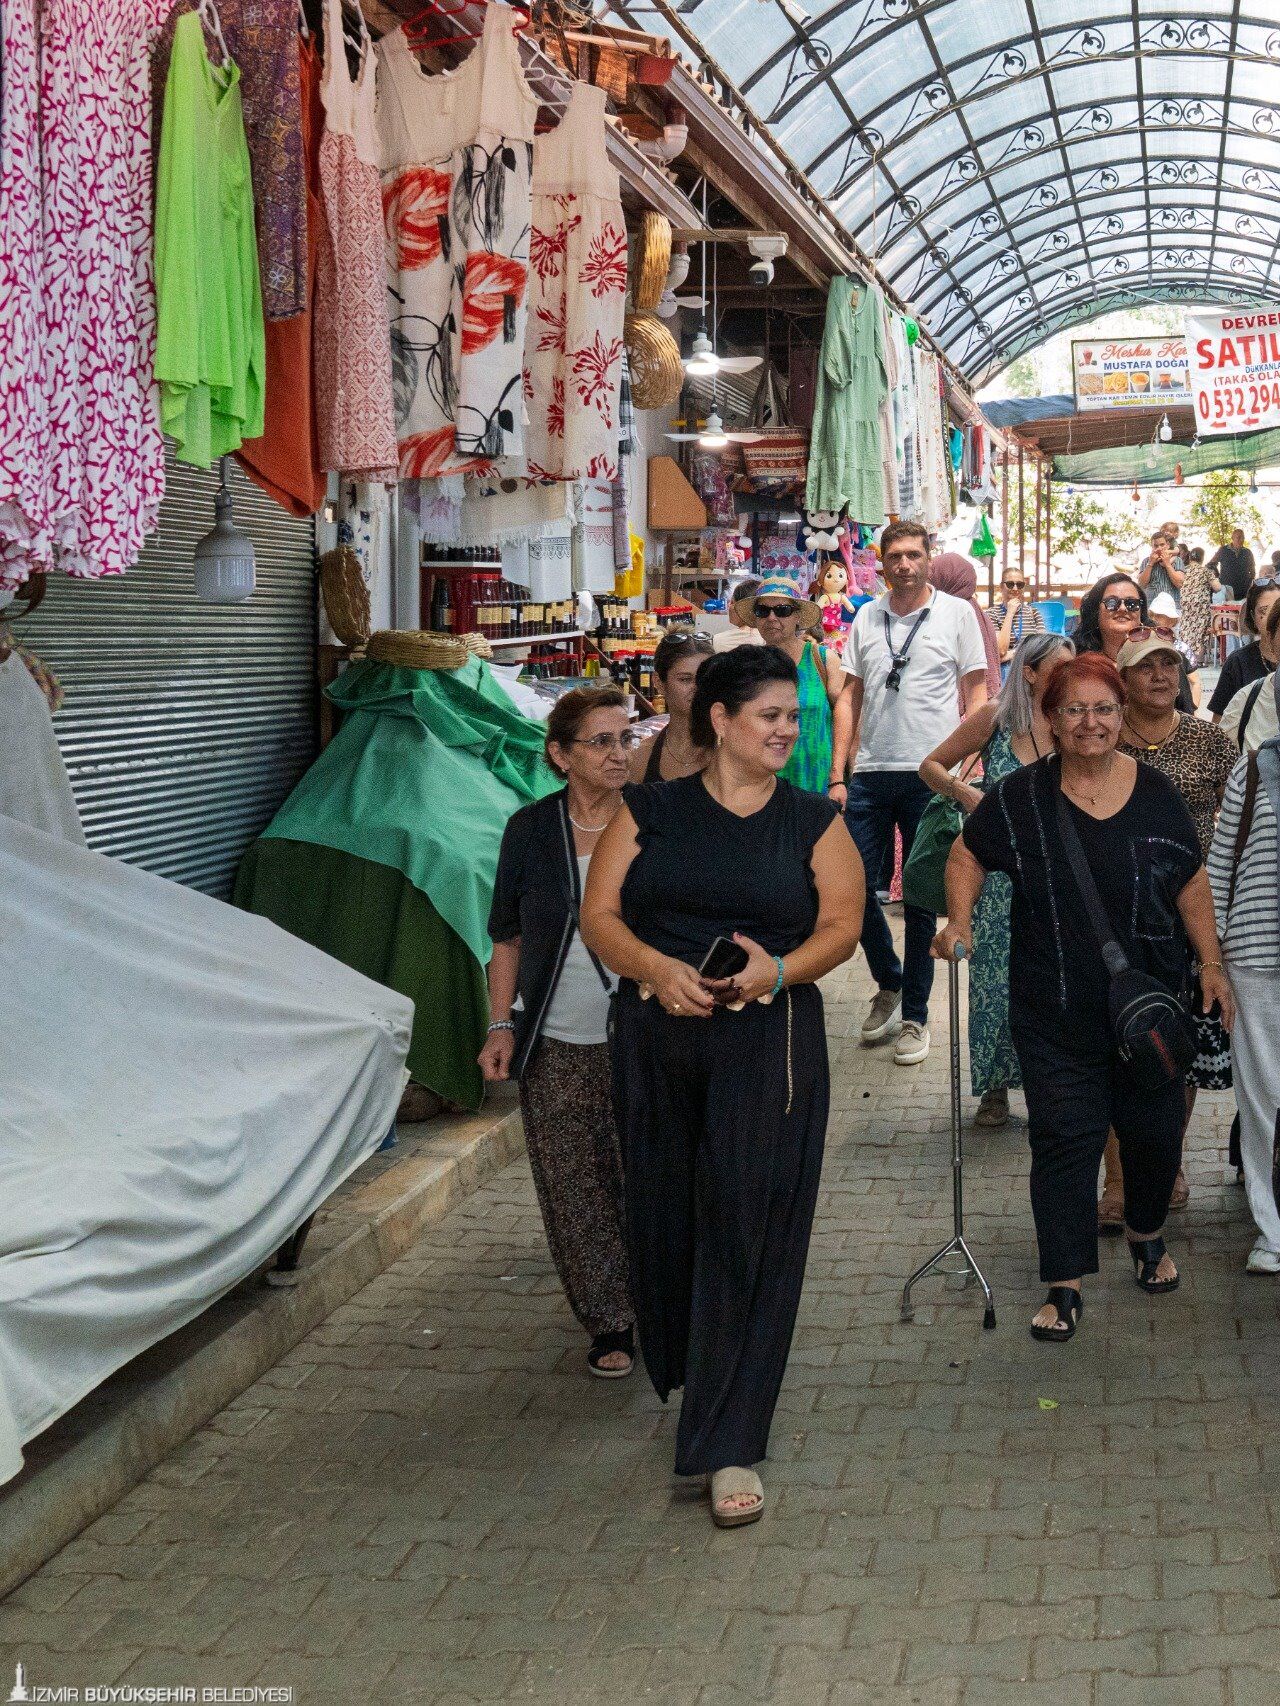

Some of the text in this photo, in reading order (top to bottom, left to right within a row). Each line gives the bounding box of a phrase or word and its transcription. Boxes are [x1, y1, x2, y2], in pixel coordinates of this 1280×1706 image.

[1103, 361, 1152, 371] MUSTAFA
[1214, 374, 1255, 388] (TAKAS
[1199, 391, 1210, 420] 0
[1213, 387, 1246, 419] 532
[1249, 382, 1280, 415] 294
